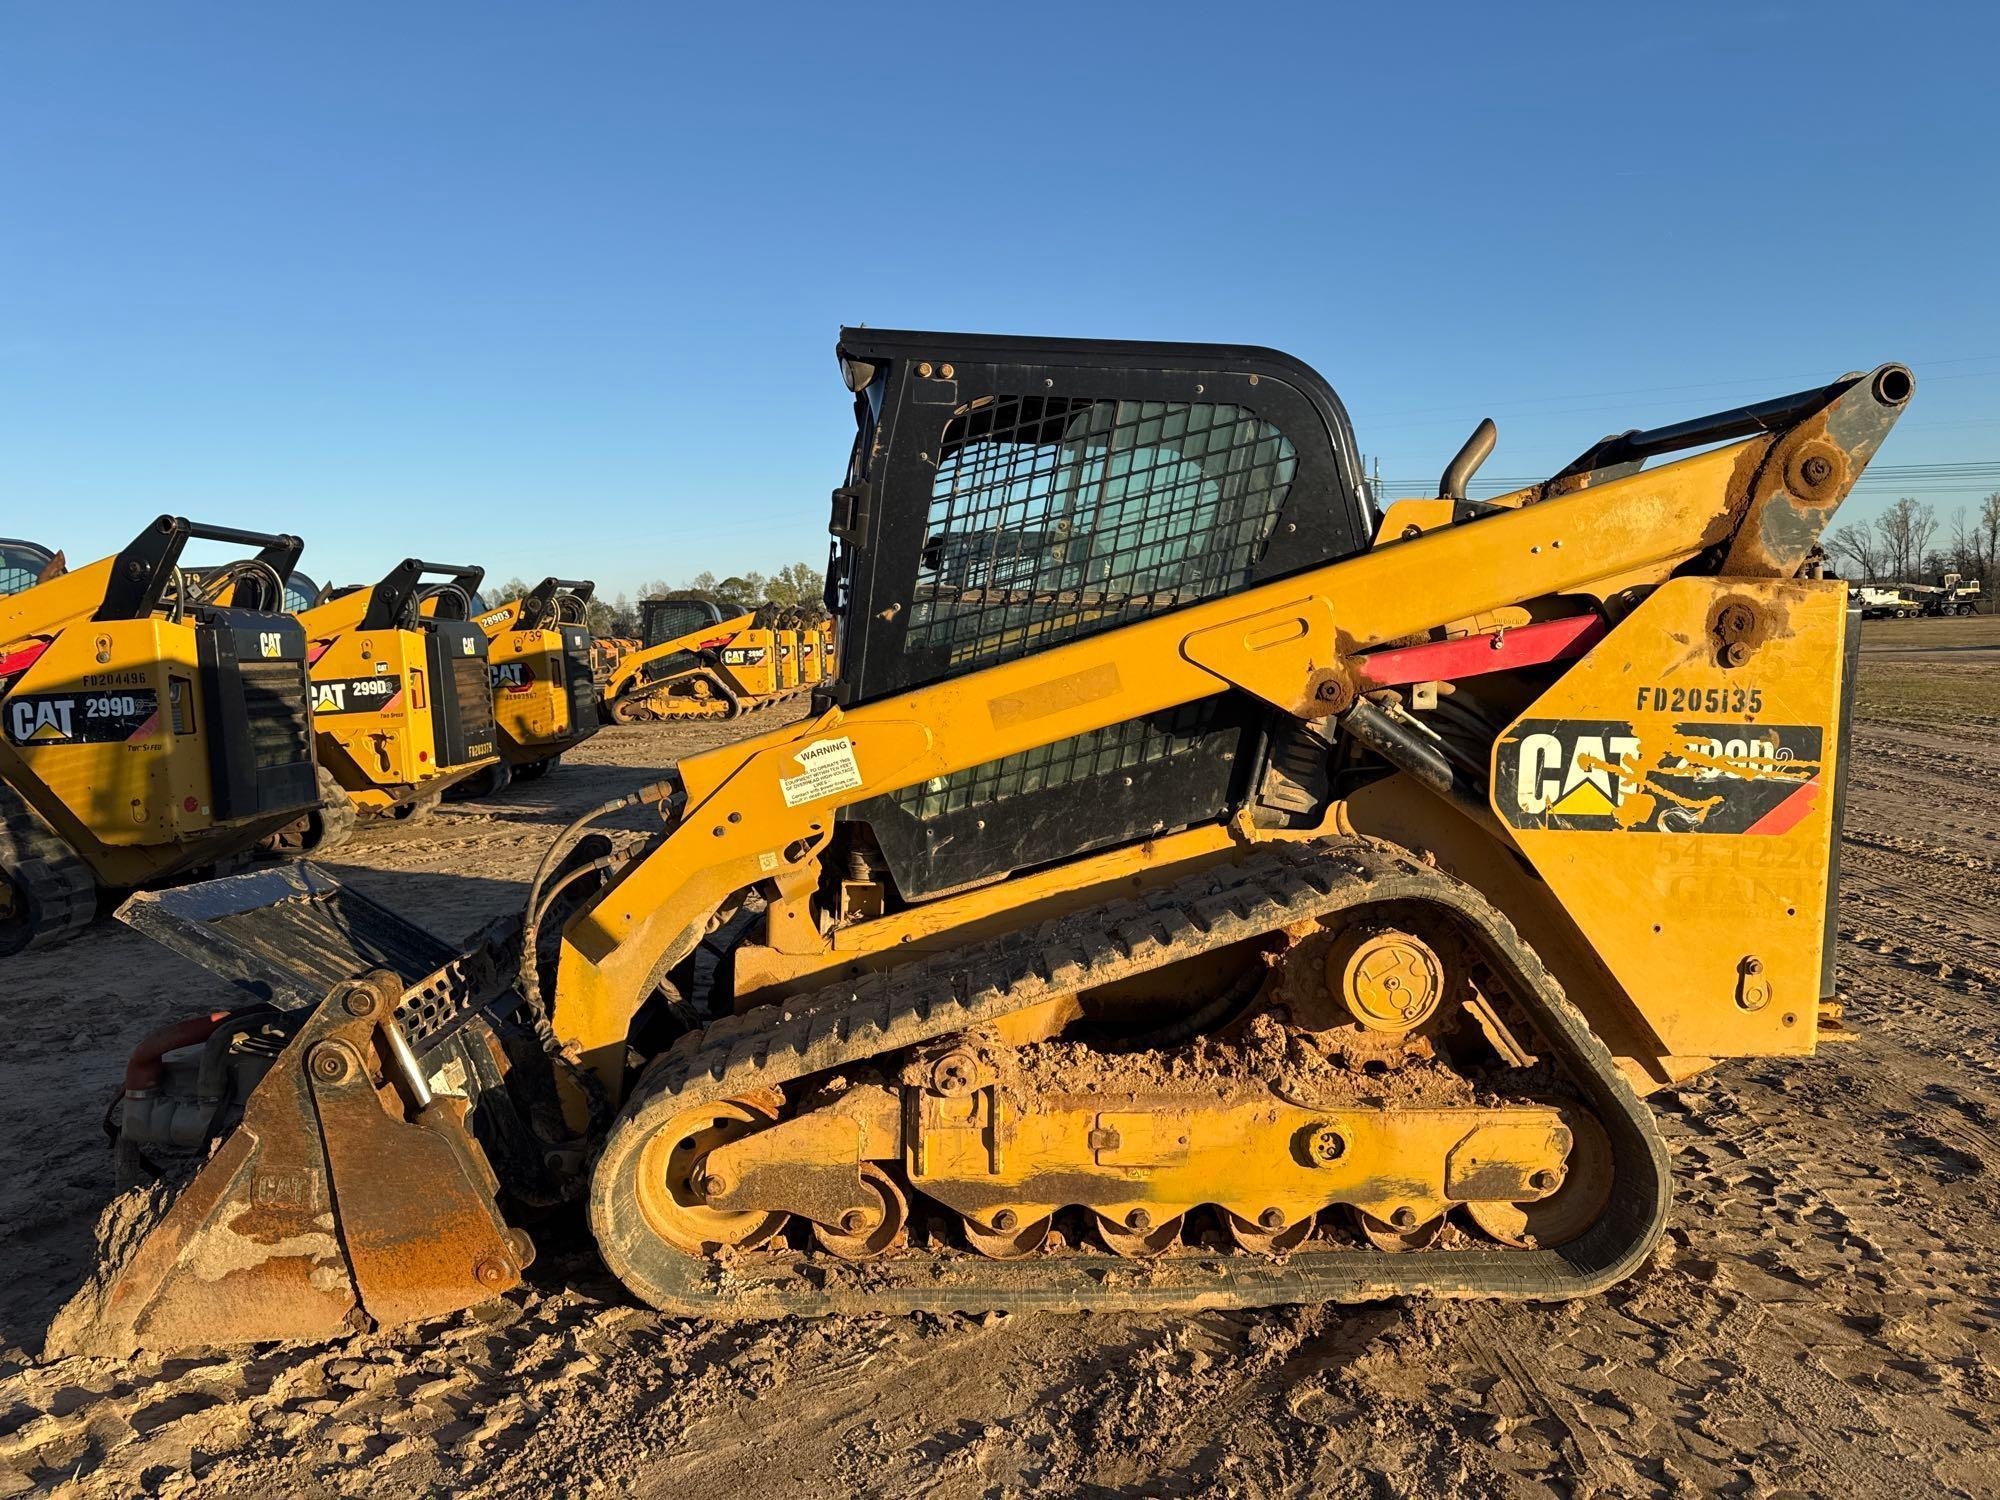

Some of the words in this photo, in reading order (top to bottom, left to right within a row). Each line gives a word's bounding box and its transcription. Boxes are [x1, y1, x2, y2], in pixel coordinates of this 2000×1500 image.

[260, 632, 281, 658] CAT
[725, 651, 744, 664] CAT
[82, 672, 146, 687] FD204496
[490, 663, 522, 687] CAT
[1636, 686, 1763, 714] FD205135
[12, 700, 75, 741] CAT
[800, 741, 846, 760] WARNING
[784, 773, 812, 785] EQUIPMENT
[813, 769, 829, 777] WITHIN
[817, 761, 838, 770] OPERATE
[1517, 733, 1640, 815] CAT
[259, 1176, 307, 1205] CAT
